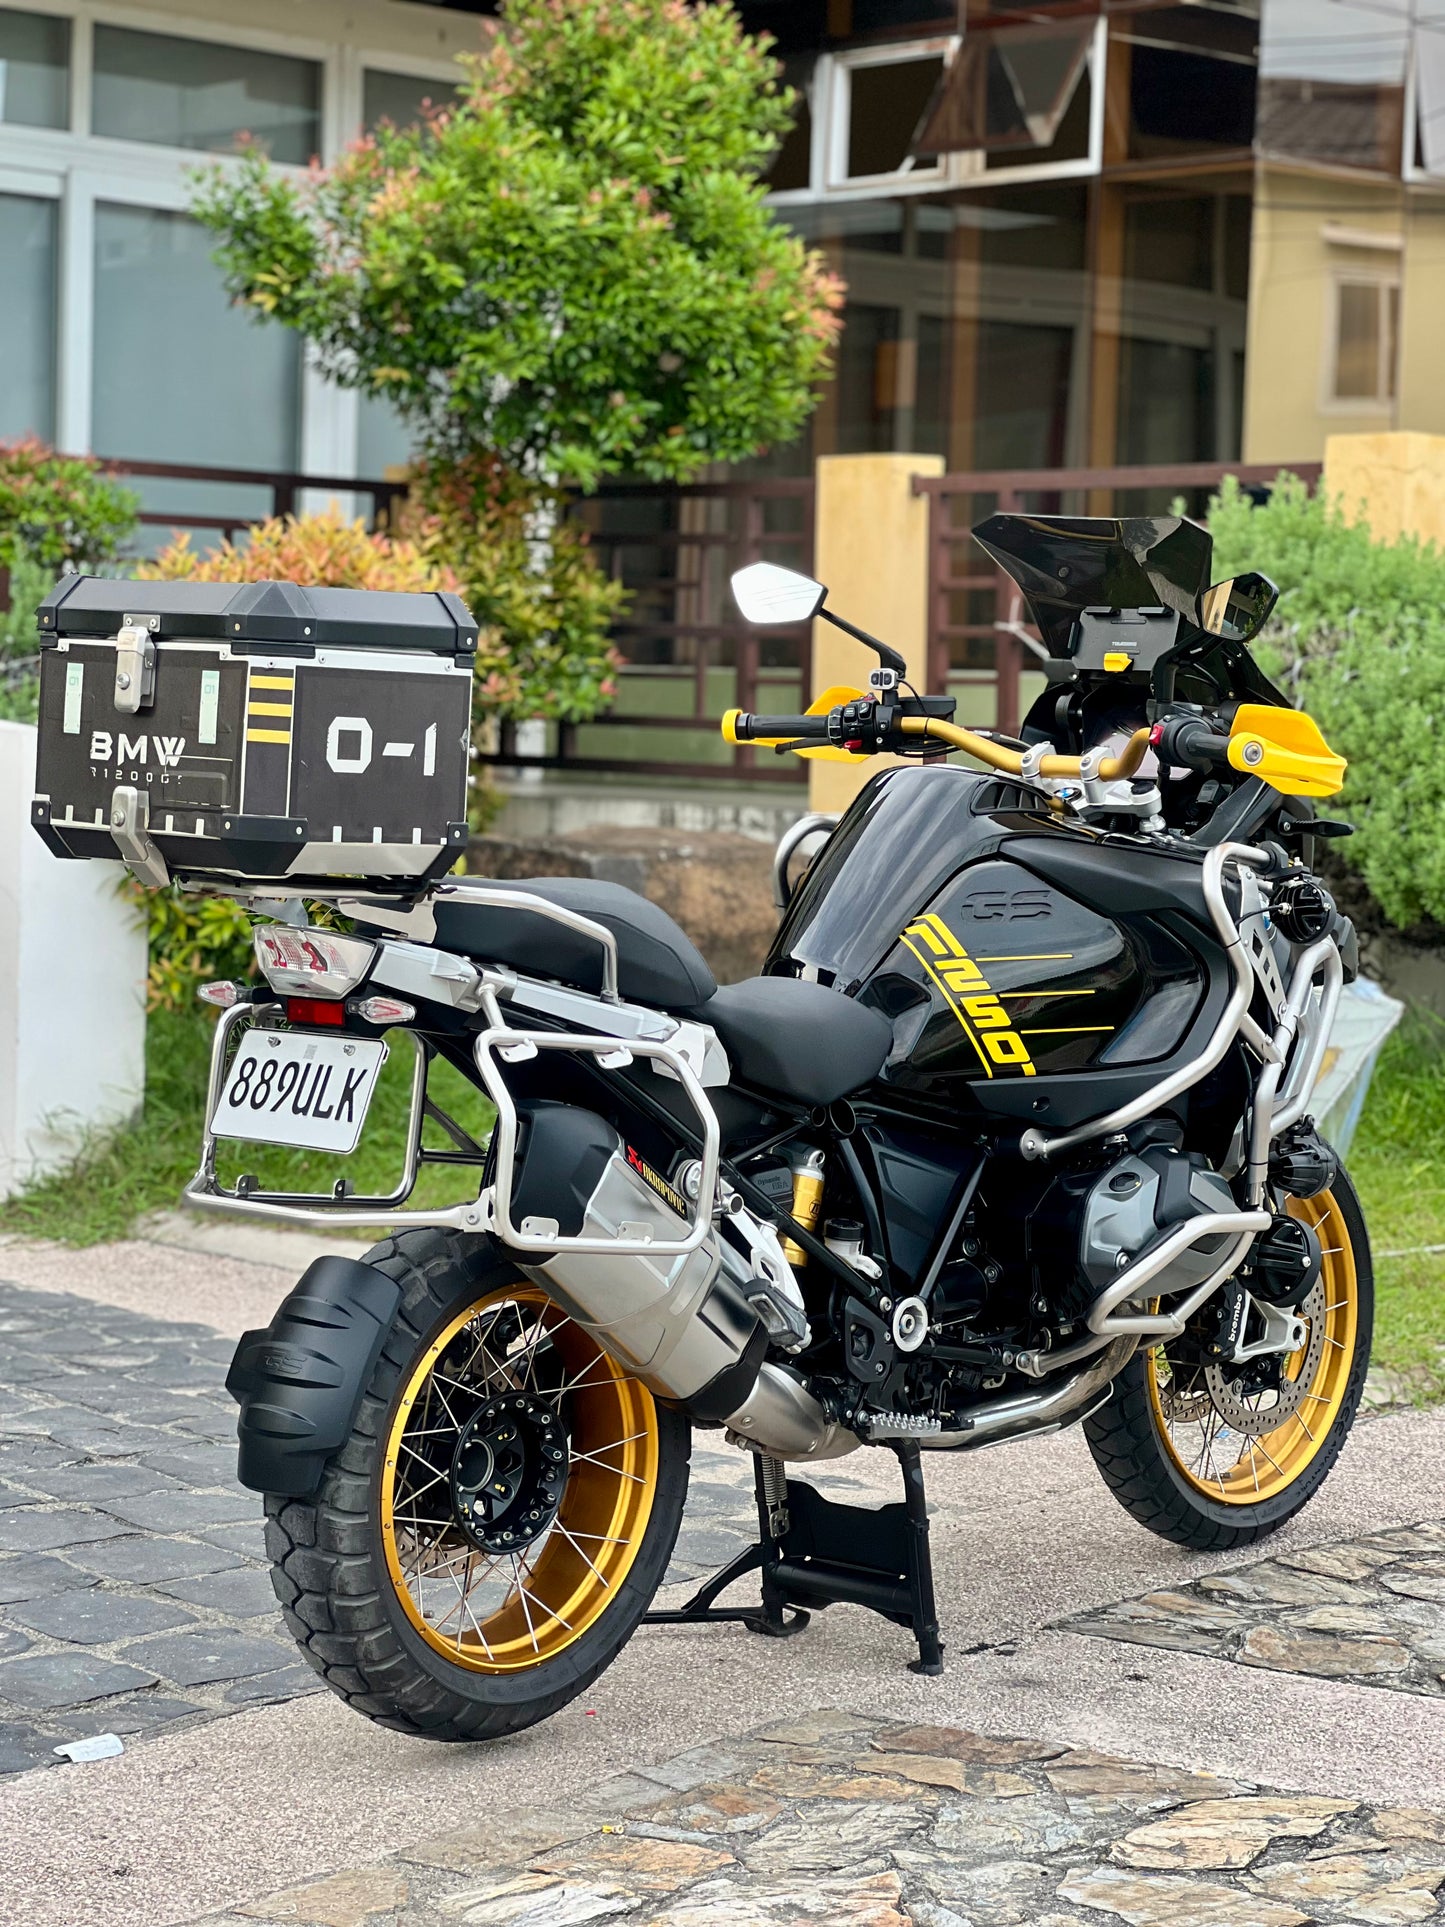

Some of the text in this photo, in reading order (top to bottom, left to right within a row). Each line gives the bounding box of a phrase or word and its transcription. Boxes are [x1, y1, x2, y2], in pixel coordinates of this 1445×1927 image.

[90, 730, 186, 767] BMW
[961, 889, 1053, 924] GS
[228, 1056, 369, 1124] 889ULK
[1228, 1293, 1243, 1342] brembo
